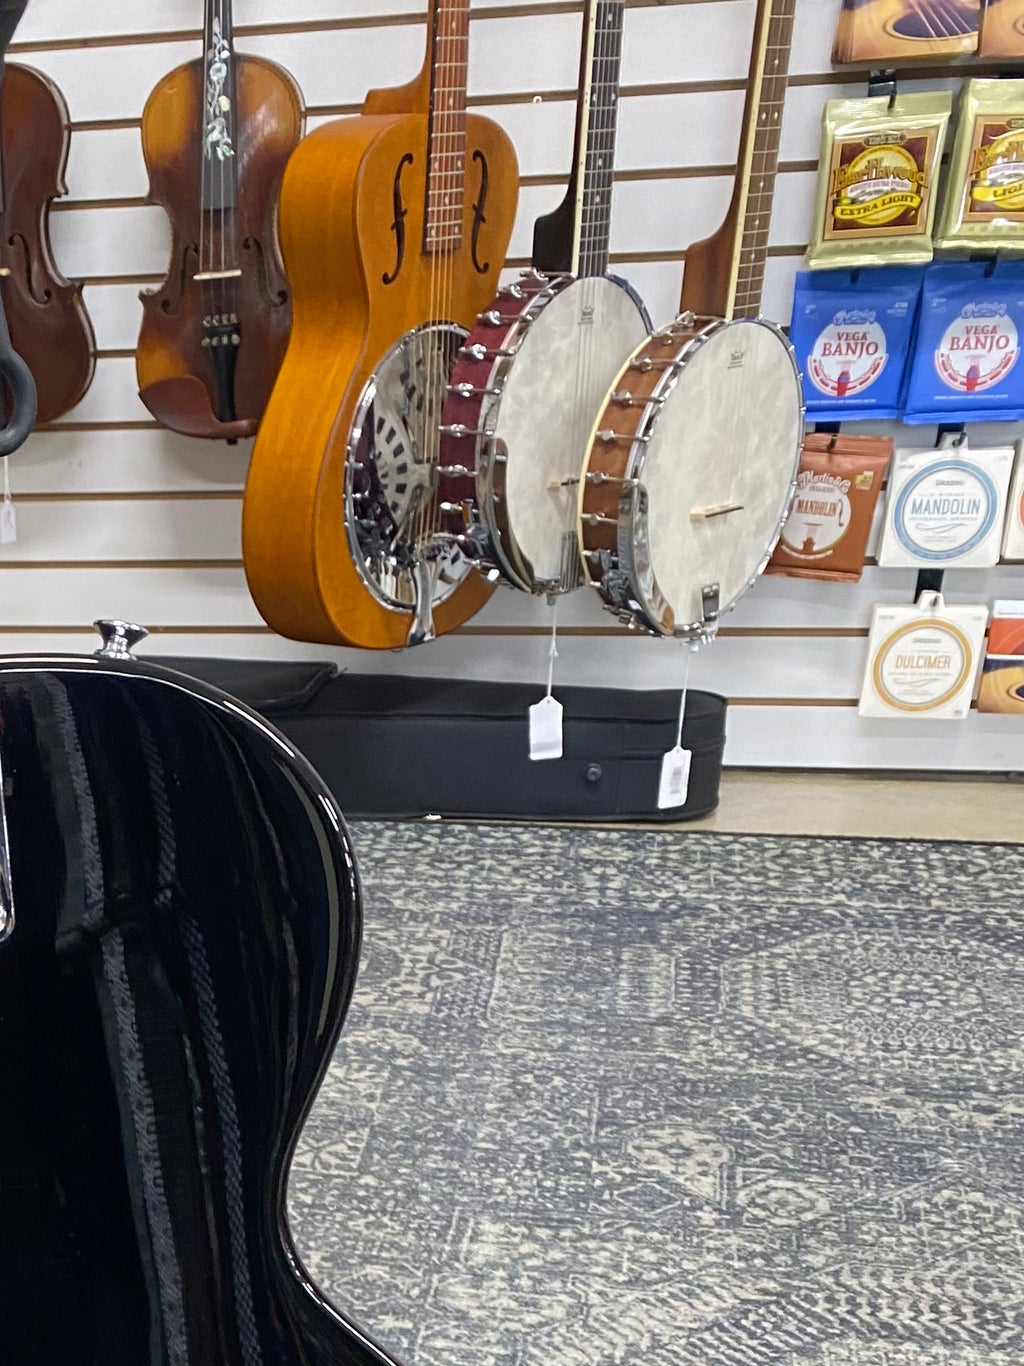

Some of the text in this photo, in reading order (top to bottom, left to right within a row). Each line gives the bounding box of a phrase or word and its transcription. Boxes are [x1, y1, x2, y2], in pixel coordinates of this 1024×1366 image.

[840, 194, 914, 216] EXTRA LIGHT
[837, 331, 869, 341] VEGA
[965, 325, 998, 335] VEGA
[821, 341, 879, 358] BANJO
[949, 334, 1010, 352] BANJO
[796, 499, 837, 517] MANDOLIN
[911, 498, 981, 516] MANDOLIN
[895, 654, 952, 669] DULCIMER
